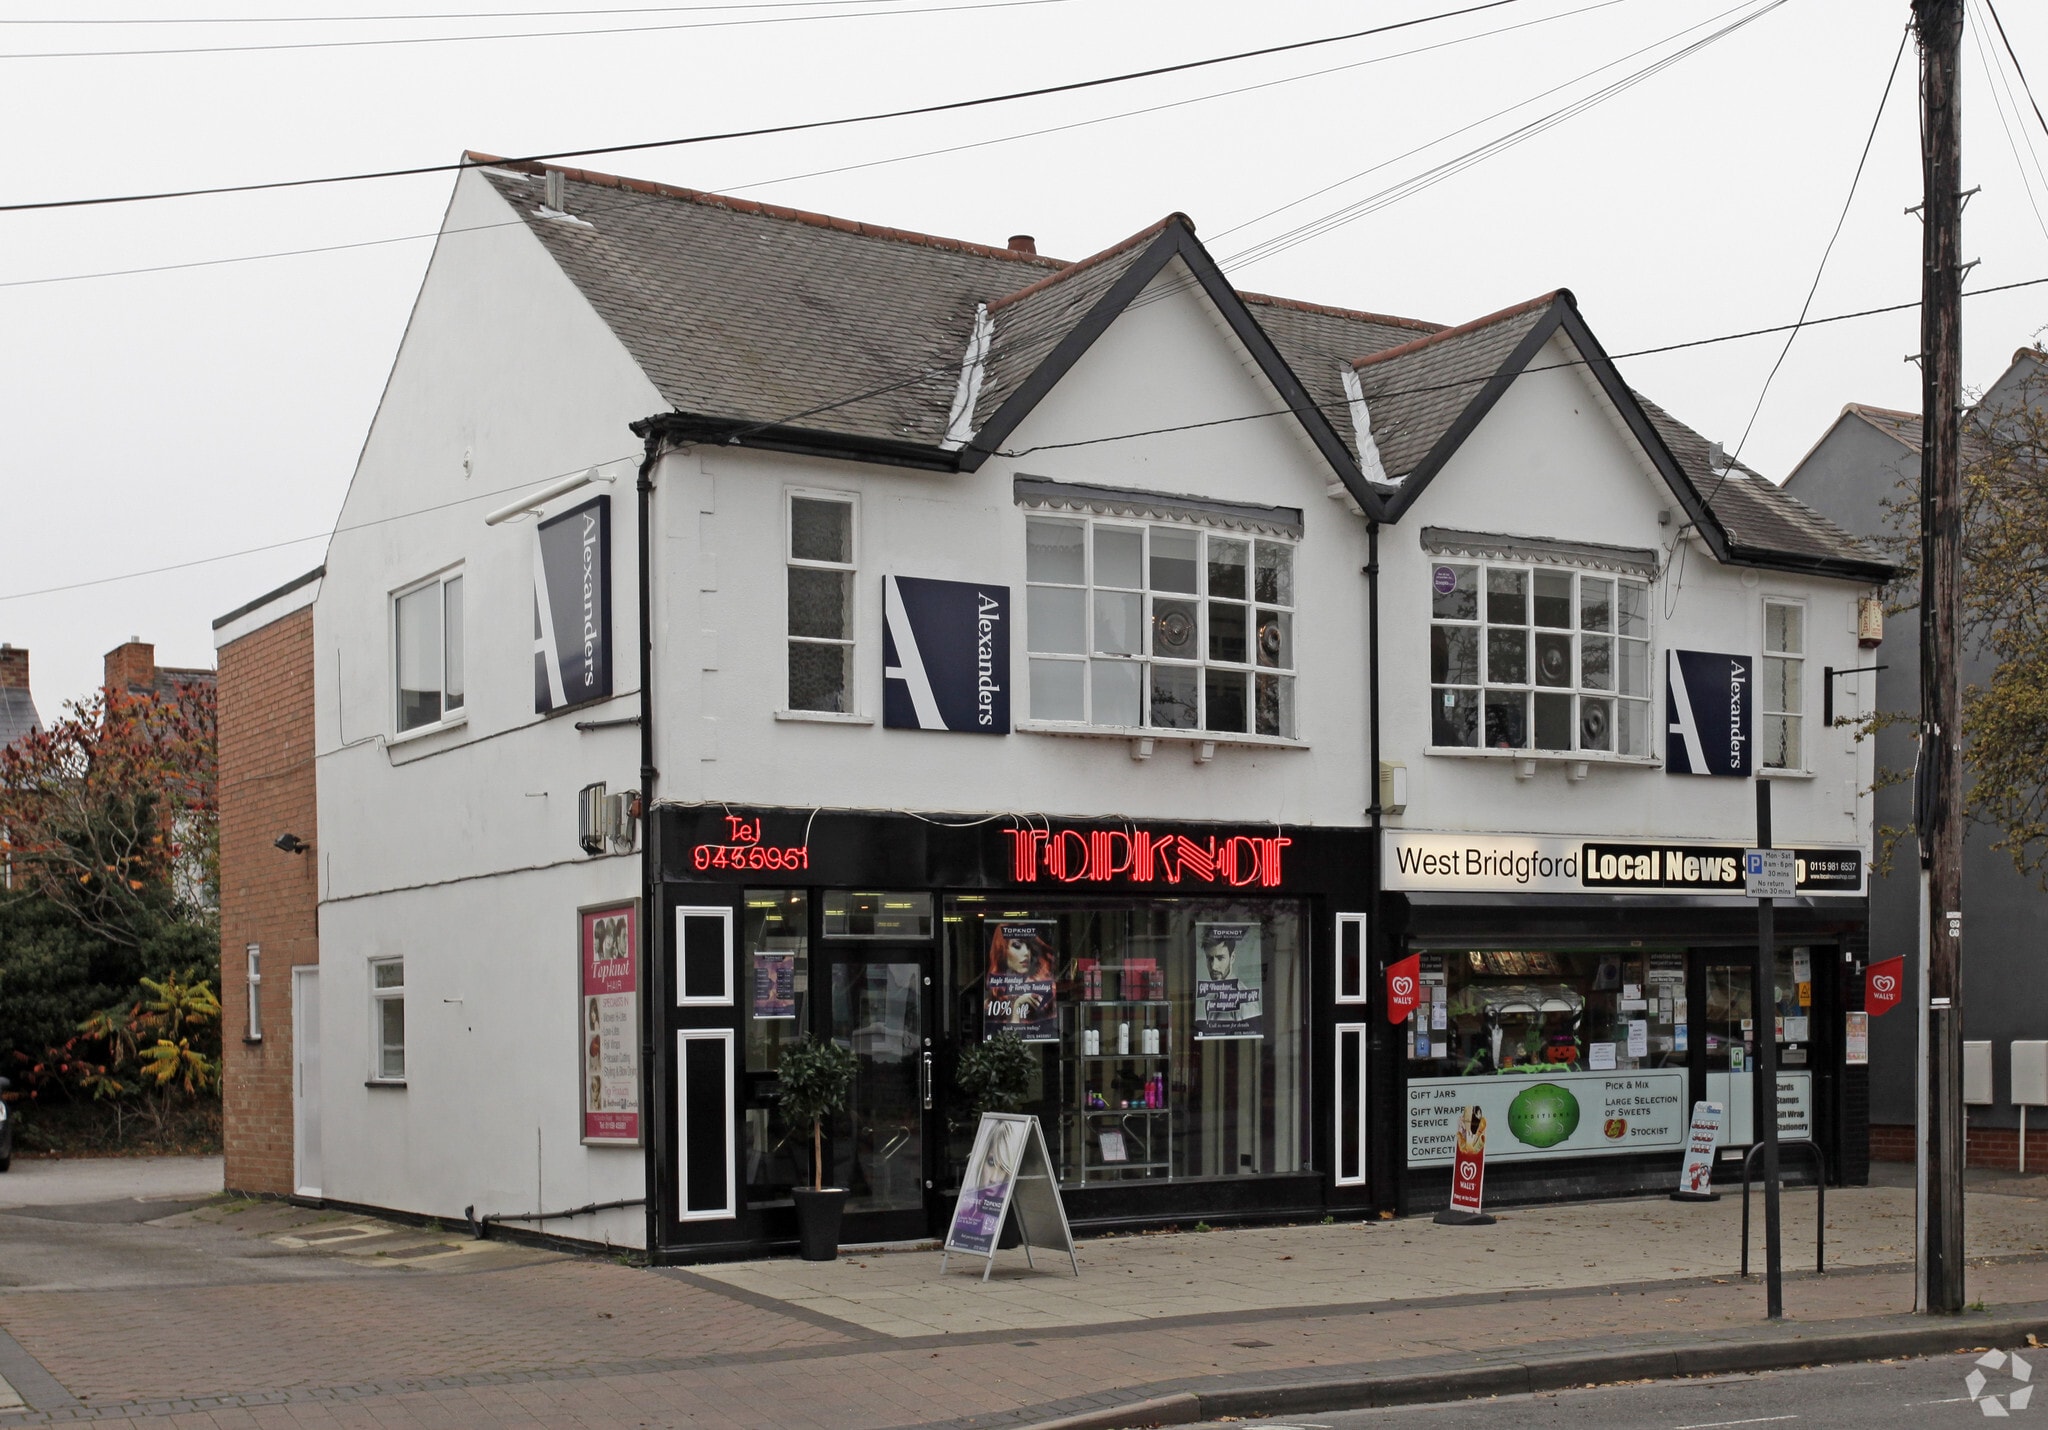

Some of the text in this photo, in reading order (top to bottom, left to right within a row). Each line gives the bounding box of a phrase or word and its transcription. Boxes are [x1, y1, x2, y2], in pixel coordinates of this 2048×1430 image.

[583, 512, 598, 687] Alexanders
[978, 591, 1000, 726] Alexanders
[1730, 660, 1746, 769] Alexanders
[725, 816, 761, 842] Tel
[1003, 828, 1292, 887] TOPKNOT
[1396, 847, 1460, 876] West
[1465, 848, 1578, 884] Bridgford
[1587, 849, 1661, 881] Local
[1665, 850, 1738, 883] News
[1751, 856, 1760, 873] P
[1809, 861, 1857, 872] 0115 981 6537
[591, 959, 629, 983] Topknot
[1393, 997, 1412, 1005] WALL'S
[1873, 992, 1894, 1000] WALL'S
[987, 1000, 1029, 1019] 10% off
[1626, 1081, 1632, 1089] &
[1787, 1110, 1804, 1119] Wrap
